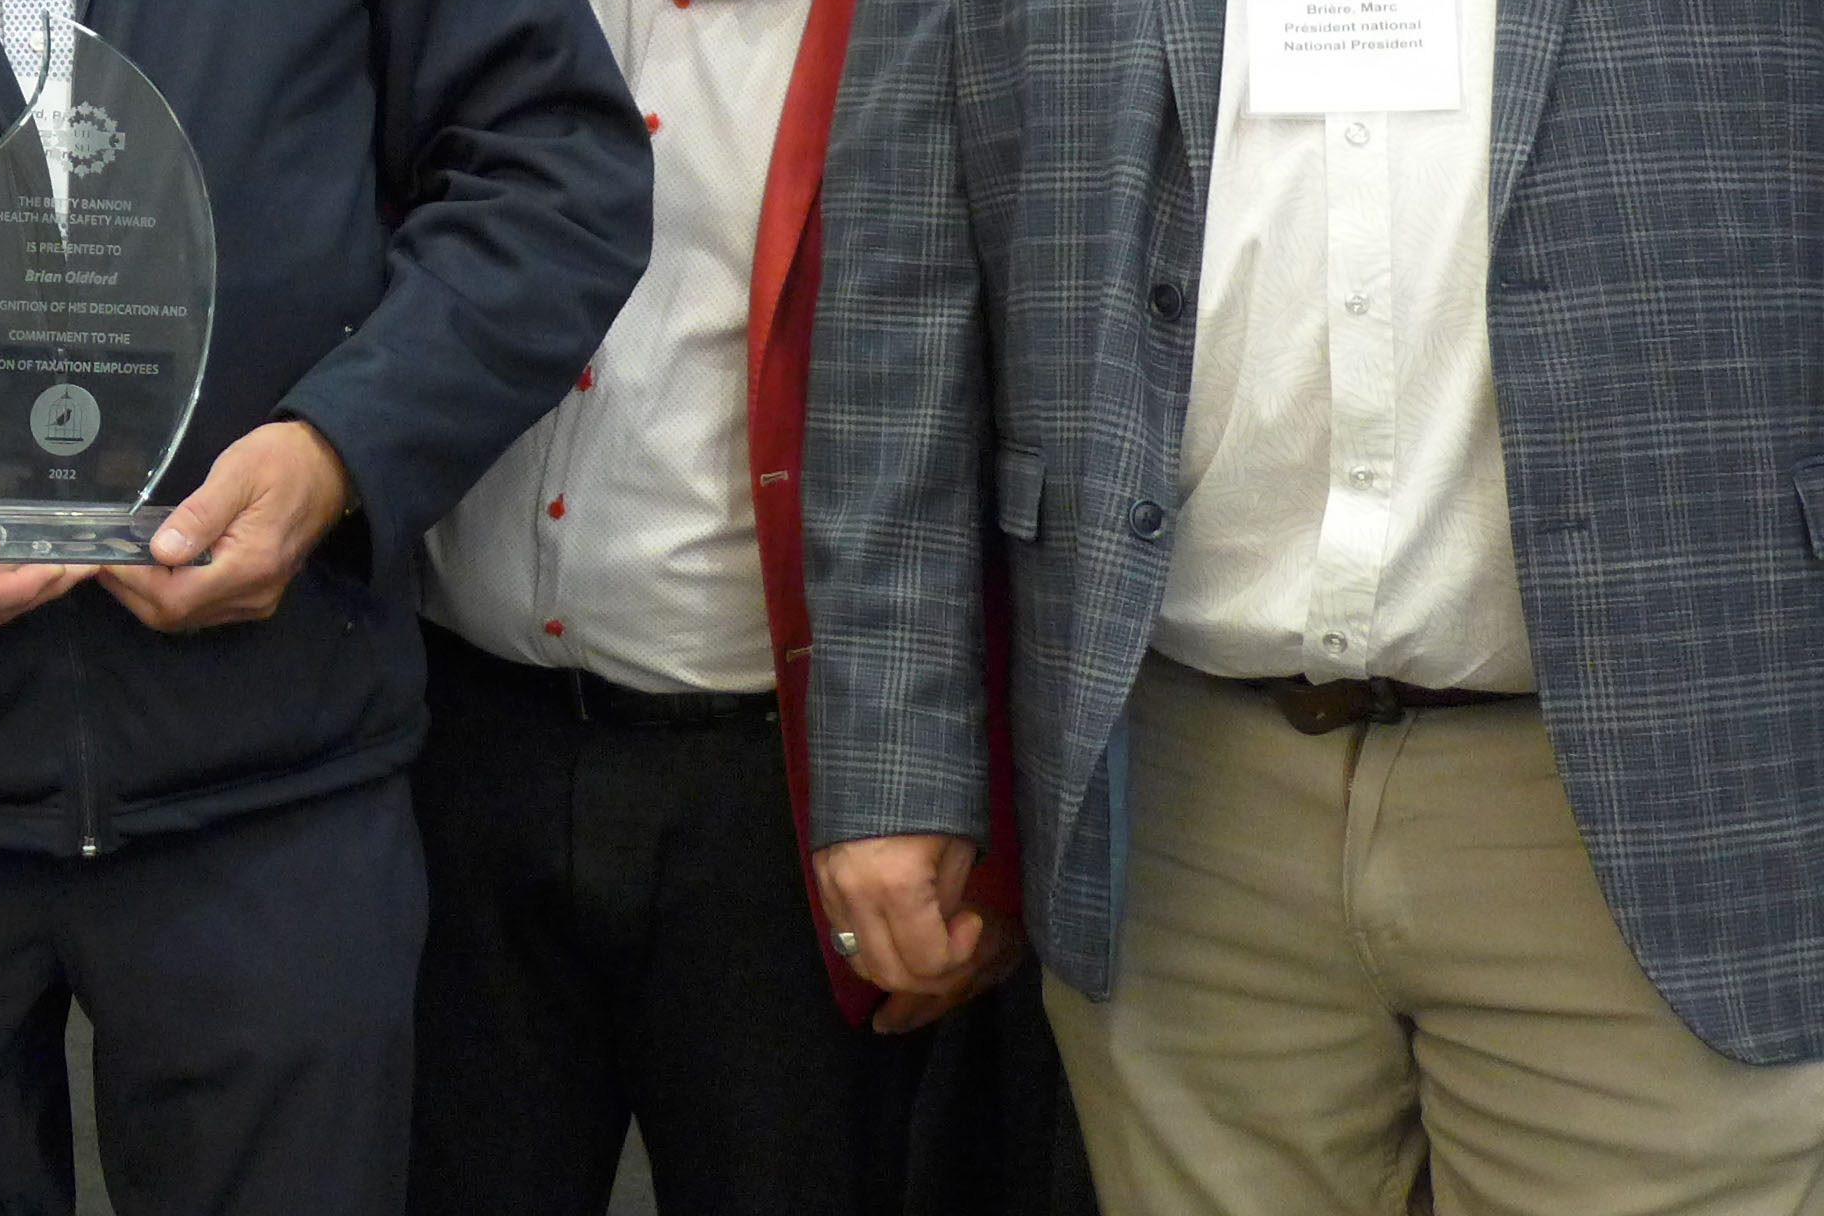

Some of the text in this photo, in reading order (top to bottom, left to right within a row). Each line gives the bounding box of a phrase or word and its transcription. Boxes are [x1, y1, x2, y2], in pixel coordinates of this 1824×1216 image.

[1361, 1, 1398, 13] Marc
[1284, 19, 1422, 33] Président national
[1283, 38, 1424, 51] National President
[18, 196, 131, 211] THE BETY BANNON
[42, 212, 66, 224] AN
[69, 214, 112, 226] SAFETY
[115, 216, 156, 228] AWARD
[26, 242, 122, 256] IS PRESENTED TO
[25, 269, 118, 285] Brian Oldford
[50, 301, 66, 313] OF
[69, 302, 87, 314] HIS
[89, 303, 159, 316] DEDICATION
[161, 305, 187, 317] AND
[9, 329, 130, 345] COMMITMENT TO THE
[17, 359, 33, 371] OF
[36, 359, 91, 372] TAXATION
[93, 361, 159, 375] EMPLOYEES
[48, 468, 77, 480] 2022
